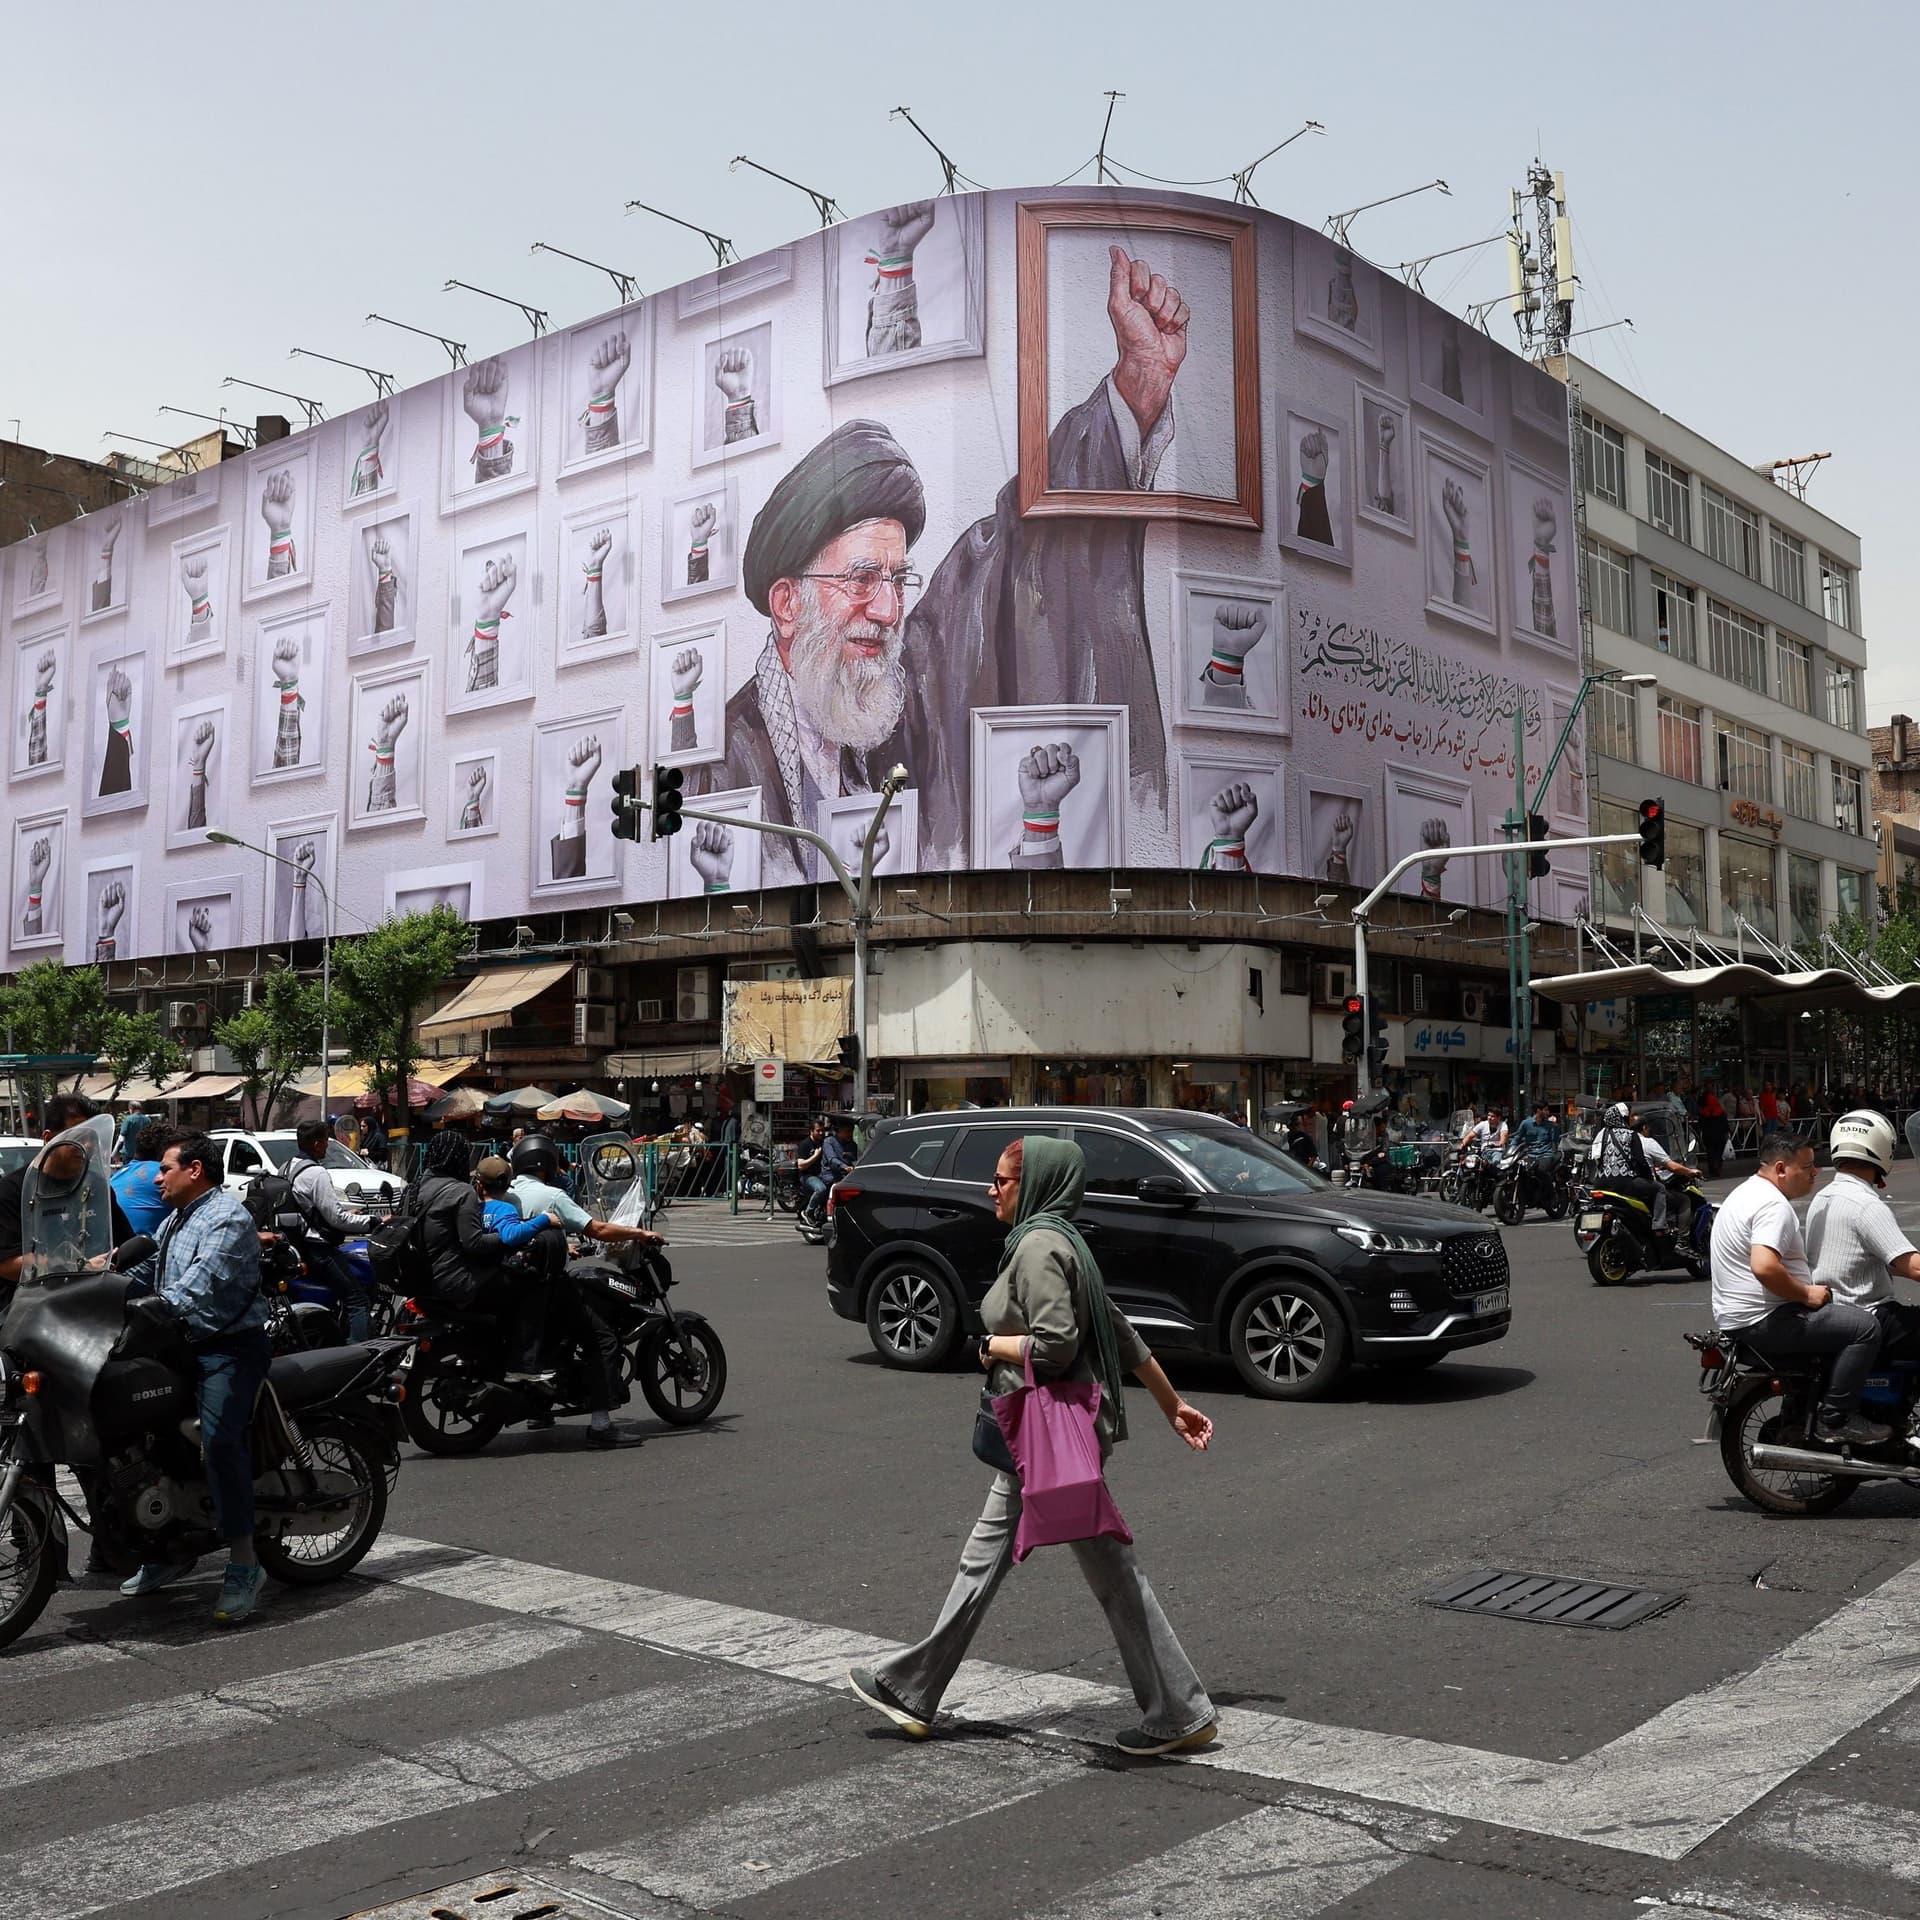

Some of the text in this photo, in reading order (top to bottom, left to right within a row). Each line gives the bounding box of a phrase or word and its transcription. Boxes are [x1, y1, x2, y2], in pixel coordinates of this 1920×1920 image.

[1414, 1024, 1466, 1052] کوه نور
[608, 1277, 637, 1295] Benelli
[132, 1386, 173, 1401] BOXER
